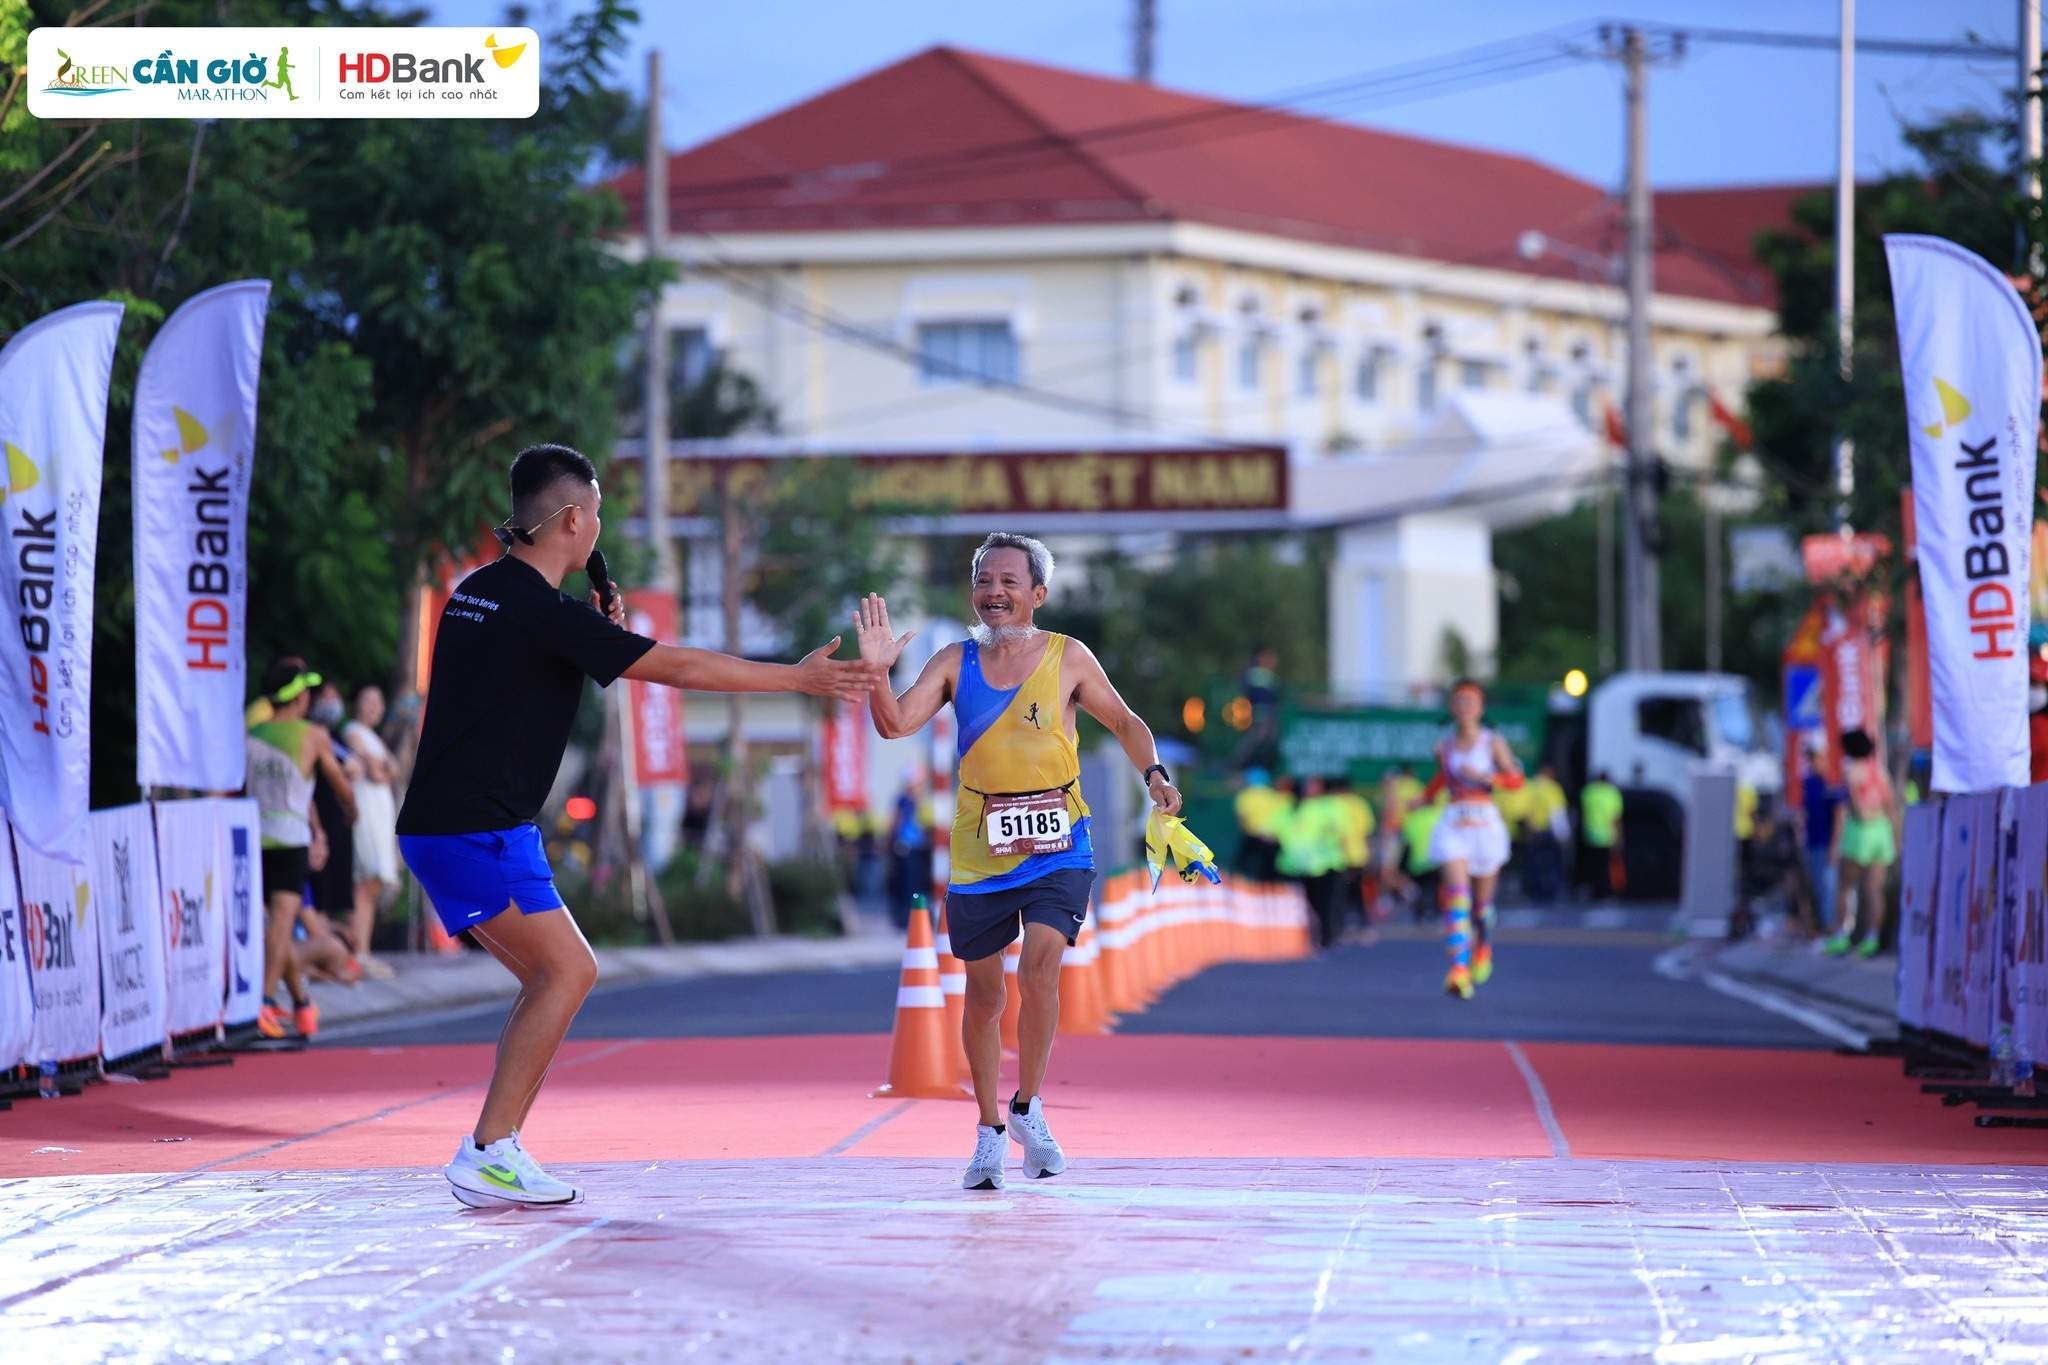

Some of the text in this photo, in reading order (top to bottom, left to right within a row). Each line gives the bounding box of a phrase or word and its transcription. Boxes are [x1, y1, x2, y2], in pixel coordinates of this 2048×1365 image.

[1150, 453, 1276, 504] NAM
[187, 466, 230, 672] HDBank
[479, 598, 499, 611] Series
[1955, 435, 2016, 662] HDBank
[12, 507, 57, 737] HDBank
[1000, 811, 1060, 837] 51185
